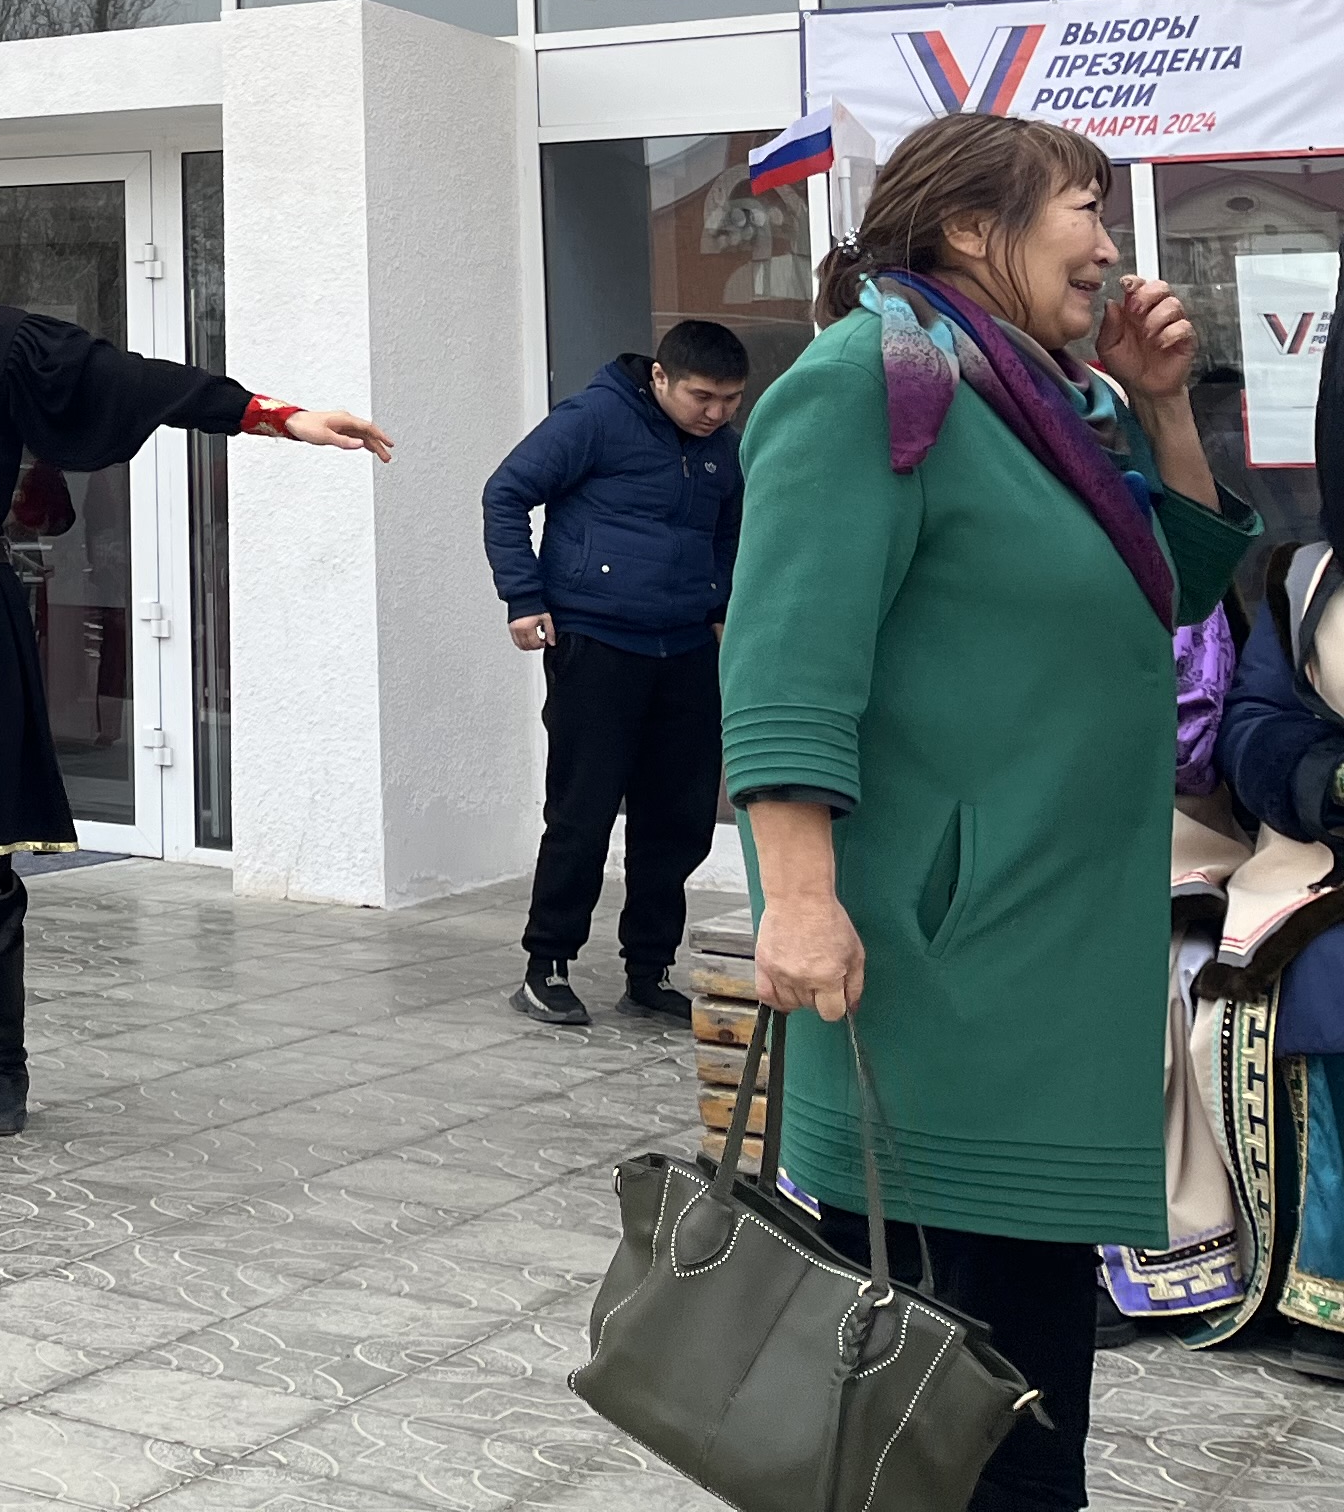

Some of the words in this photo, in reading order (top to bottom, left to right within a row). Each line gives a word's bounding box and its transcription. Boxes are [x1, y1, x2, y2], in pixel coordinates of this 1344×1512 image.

[1060, 15, 1200, 46] ВЫБОРЫ
[1045, 45, 1243, 79] ПРЕЗИДЕНТА
[1031, 83, 1158, 111] РОССИИ
[1085, 115, 1159, 137] МАРТА
[1163, 111, 1216, 134] 2024
